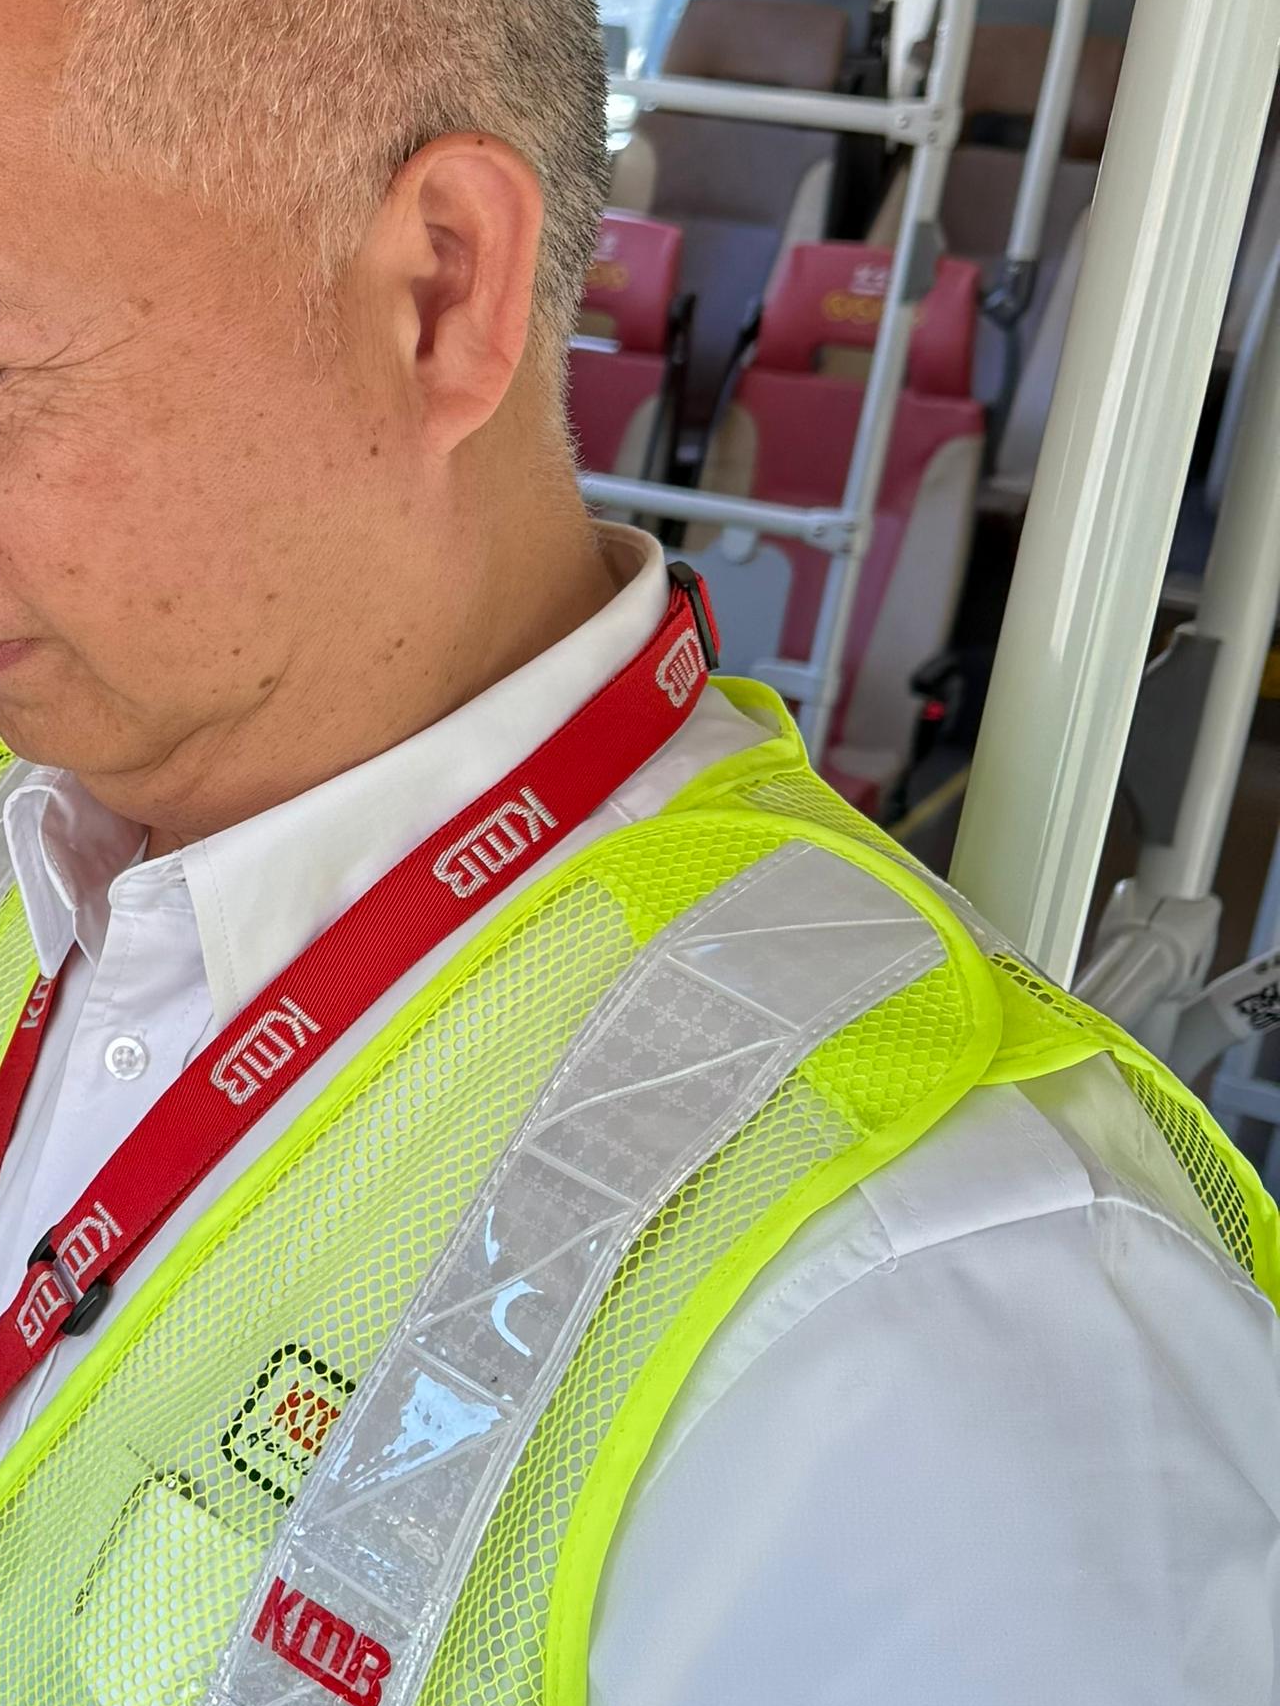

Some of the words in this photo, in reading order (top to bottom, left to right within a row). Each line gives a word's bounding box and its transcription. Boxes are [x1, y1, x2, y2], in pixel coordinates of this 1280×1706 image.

[432, 787, 559, 898] KMB
[210, 995, 321, 1105] KMB
[57, 1201, 123, 1283] KM
